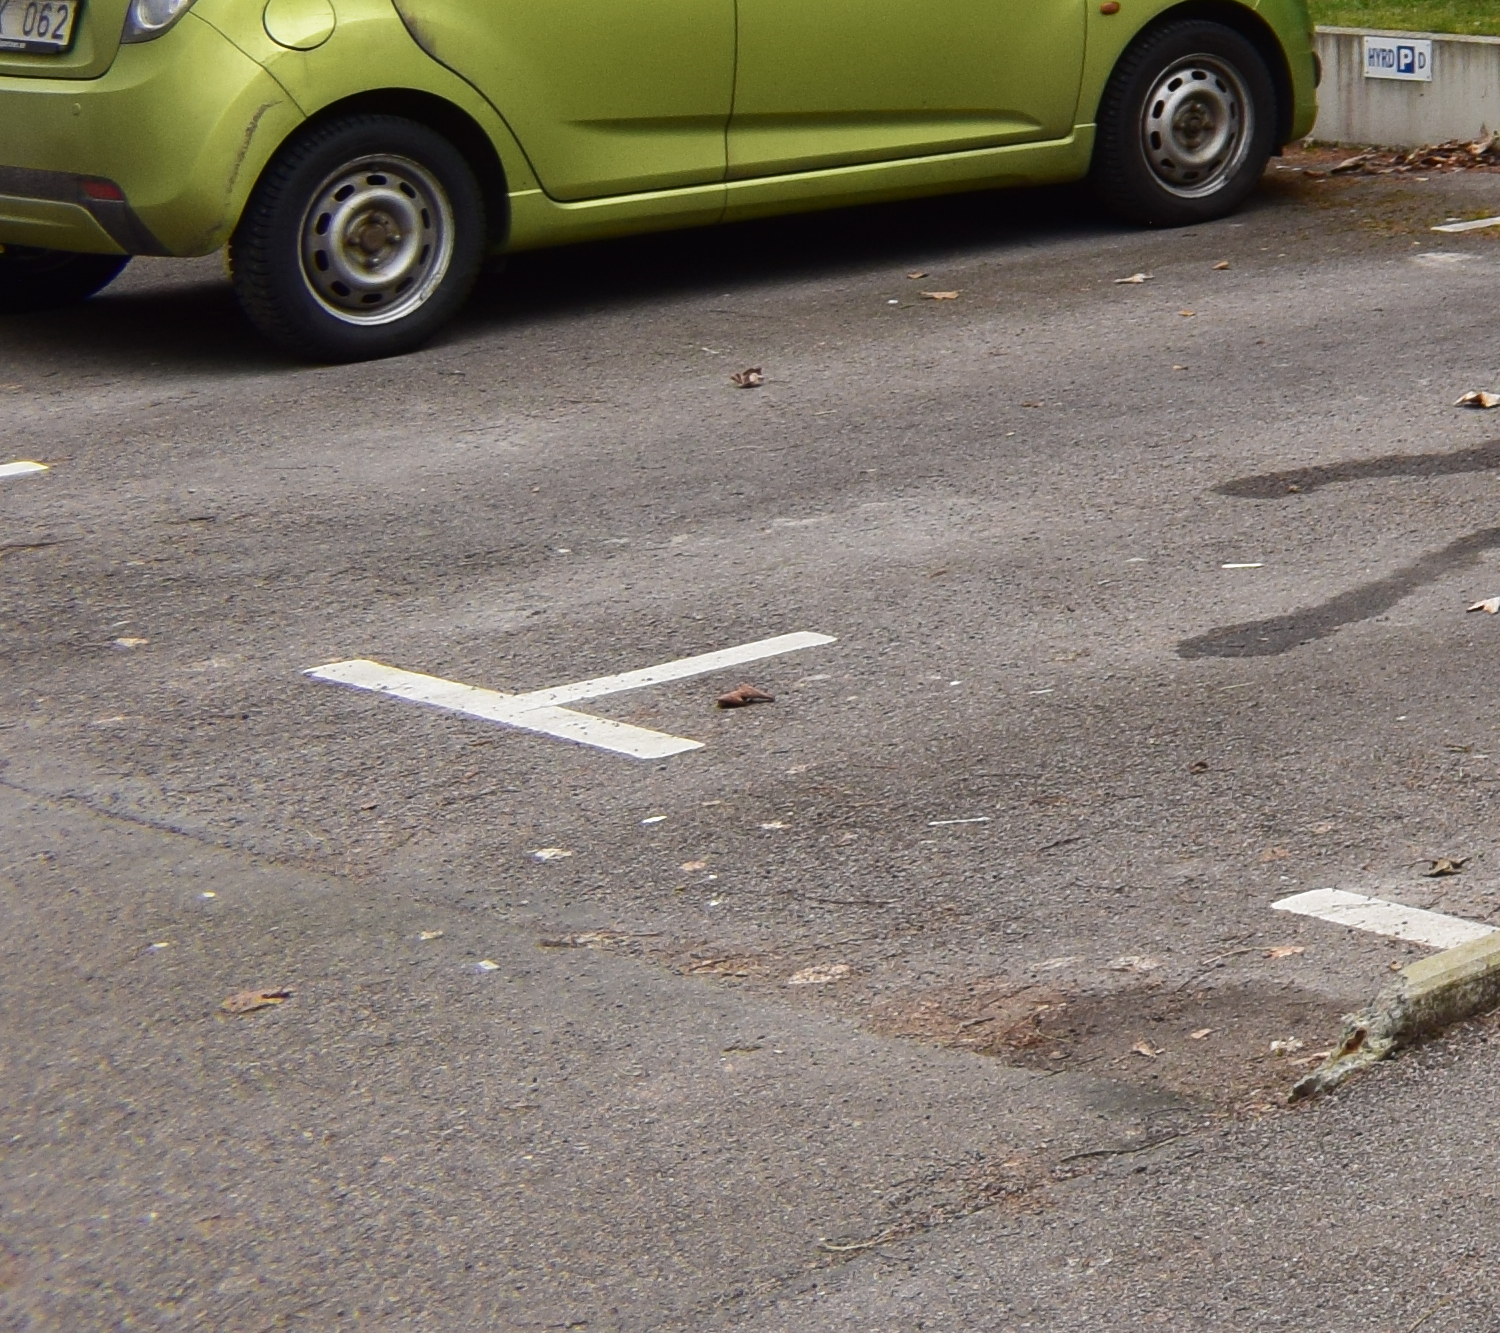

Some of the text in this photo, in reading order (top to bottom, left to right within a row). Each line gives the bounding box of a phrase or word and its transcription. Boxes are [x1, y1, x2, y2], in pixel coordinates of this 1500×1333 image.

[1368, 47, 1427, 71] HYRD P D
